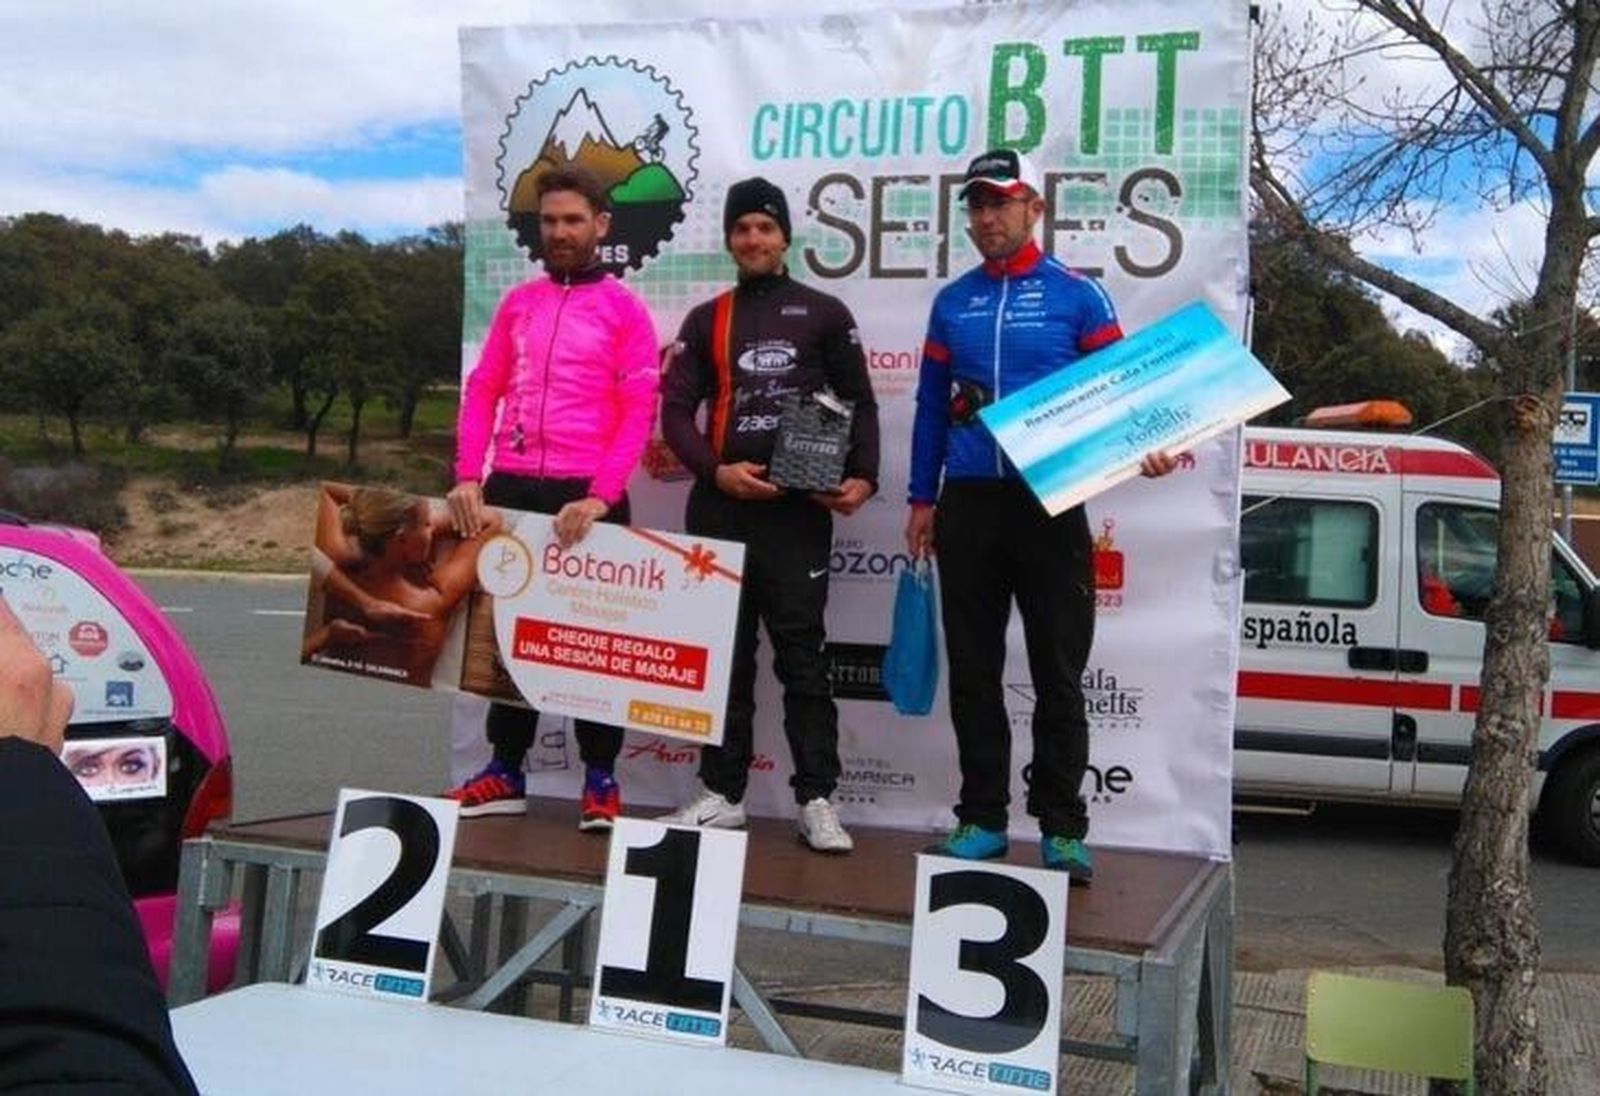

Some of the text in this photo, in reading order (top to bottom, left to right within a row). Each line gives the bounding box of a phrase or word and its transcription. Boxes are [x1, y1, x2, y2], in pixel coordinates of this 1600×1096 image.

[752, 30, 1201, 160] CIRCUITO BTT
[804, 168, 1183, 279] SEES
[595, 244, 629, 263] ES
[869, 346, 919, 369] tani
[1244, 442, 1391, 473] ULANCIA
[542, 542, 665, 592] Botanik
[547, 627, 676, 661] CHEQUE REGALO
[1244, 610, 1358, 649] spañola
[519, 641, 698, 684] UNA SESIÓN DE MASAJE
[1083, 670, 1117, 691] ala
[841, 771, 914, 785] MANCA
[314, 795, 441, 973] 2
[601, 828, 725, 1014] 1
[916, 870, 1049, 1054] 3
